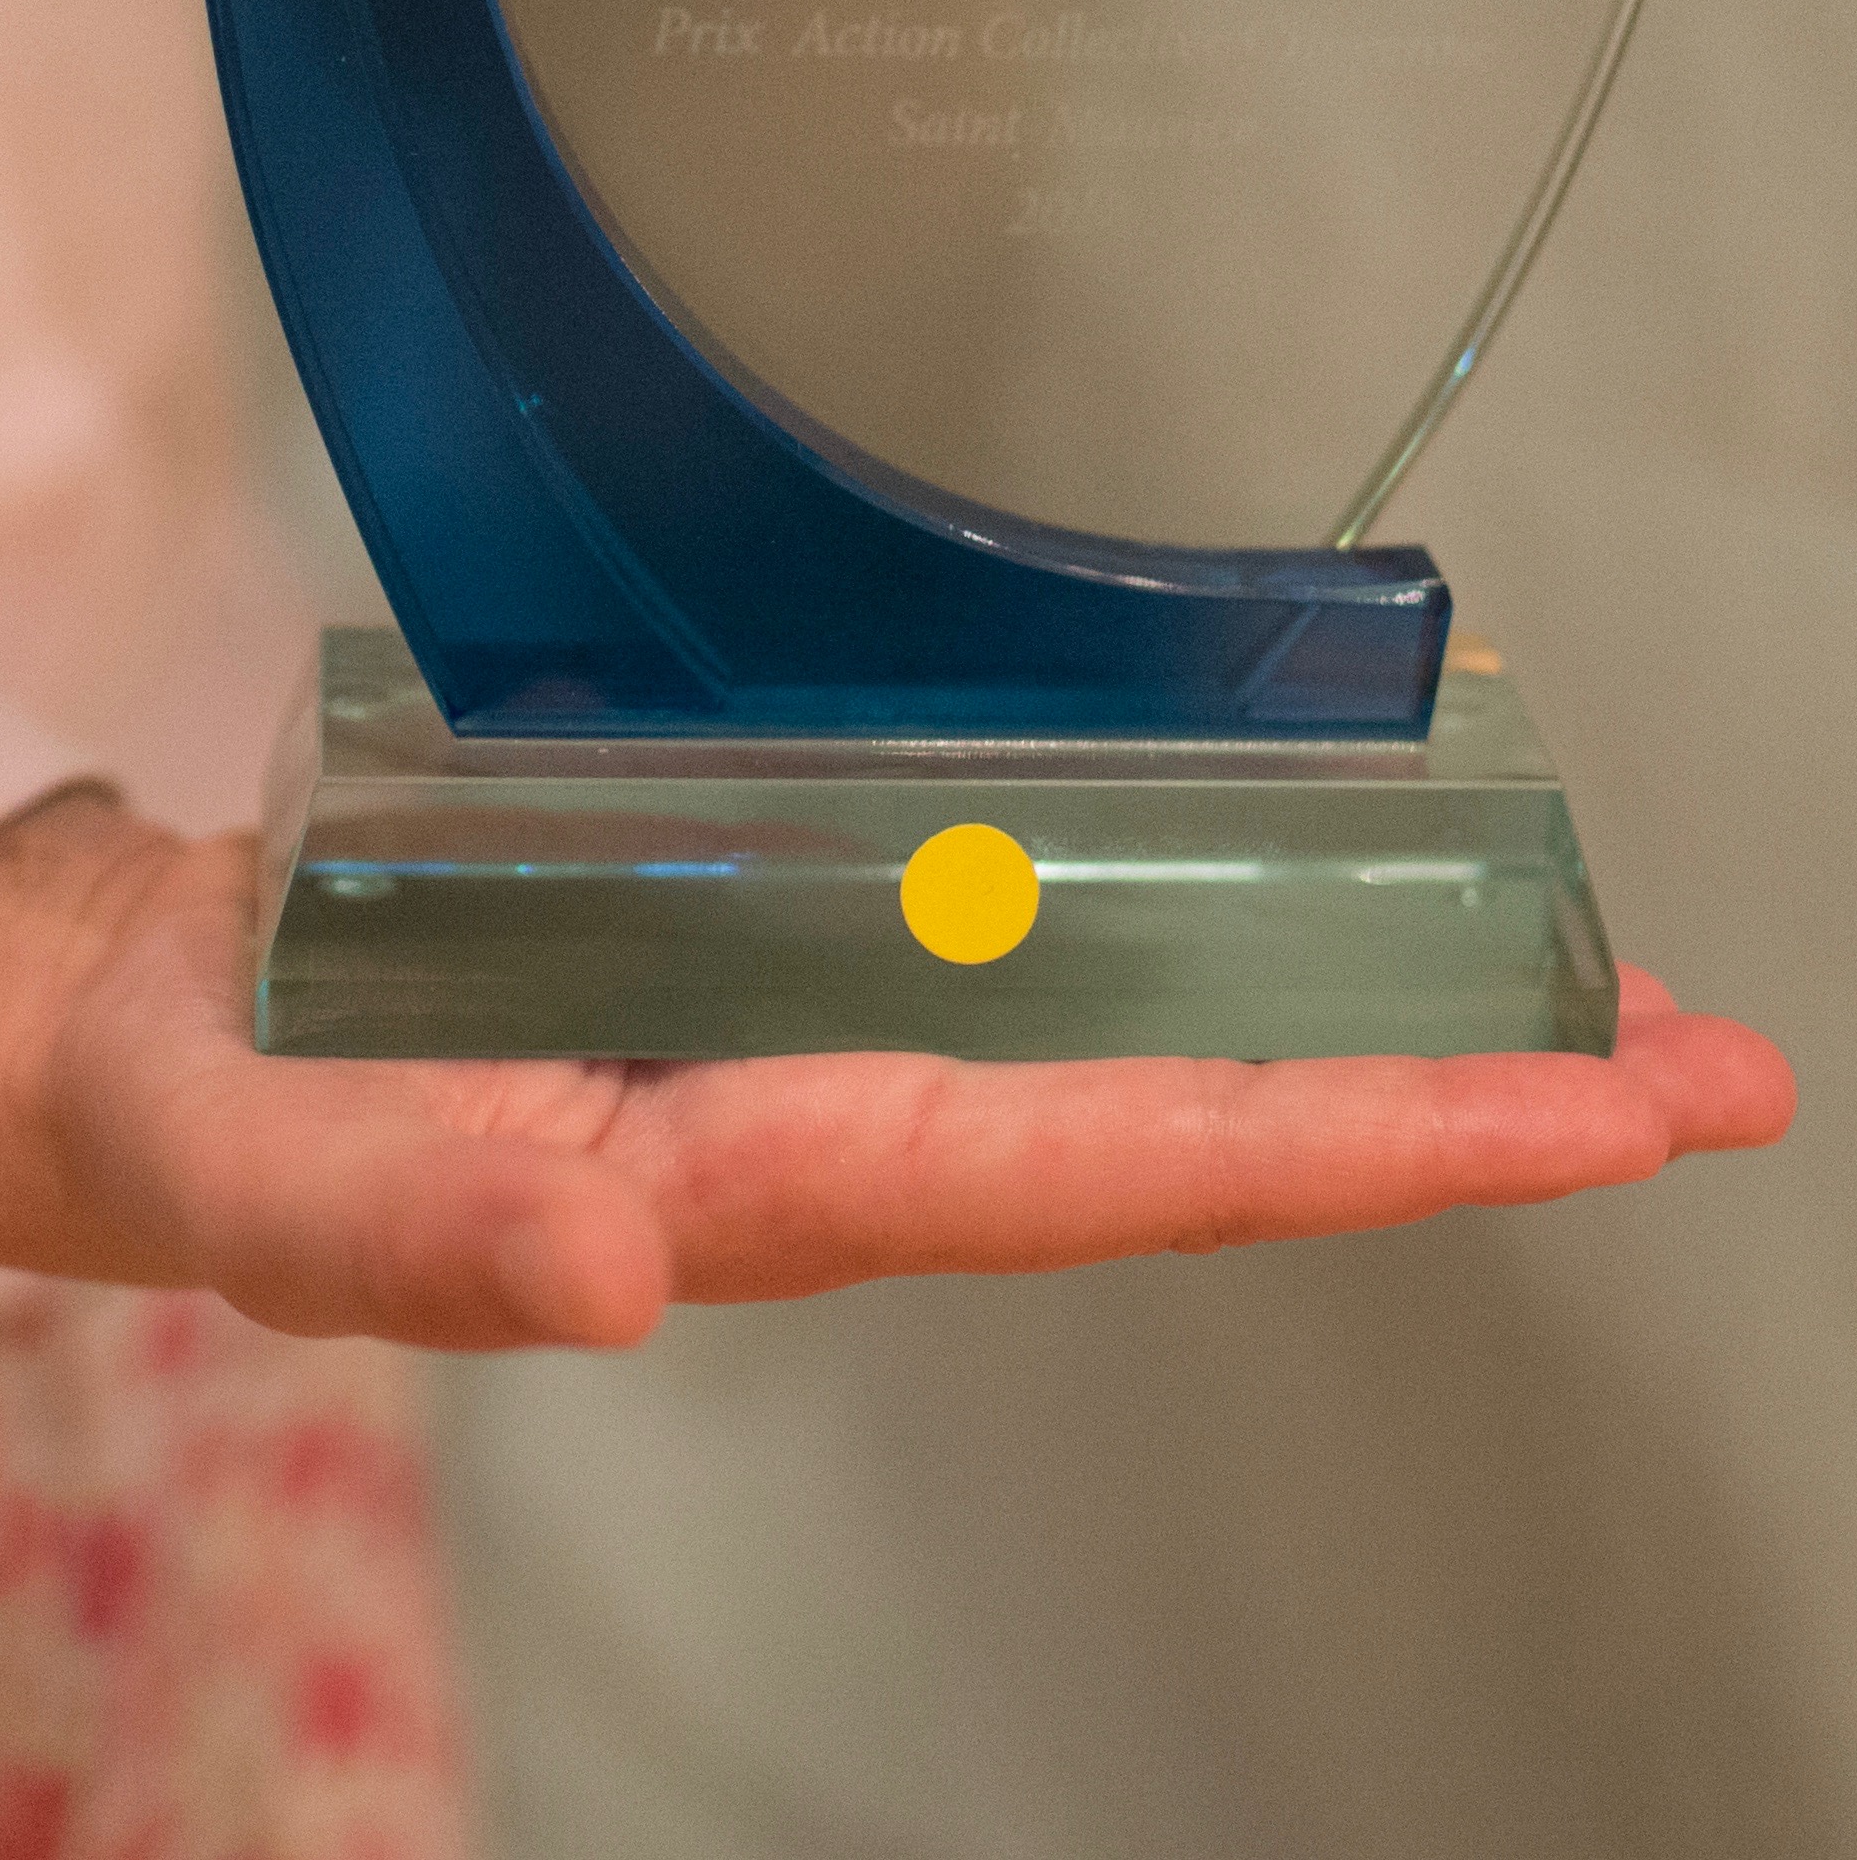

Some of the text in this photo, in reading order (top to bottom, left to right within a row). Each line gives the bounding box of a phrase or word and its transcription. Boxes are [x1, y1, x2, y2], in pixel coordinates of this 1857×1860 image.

[652, 6, 766, 58] Prix
[792, 8, 964, 61] Action
[887, 96, 1023, 148] Saint
